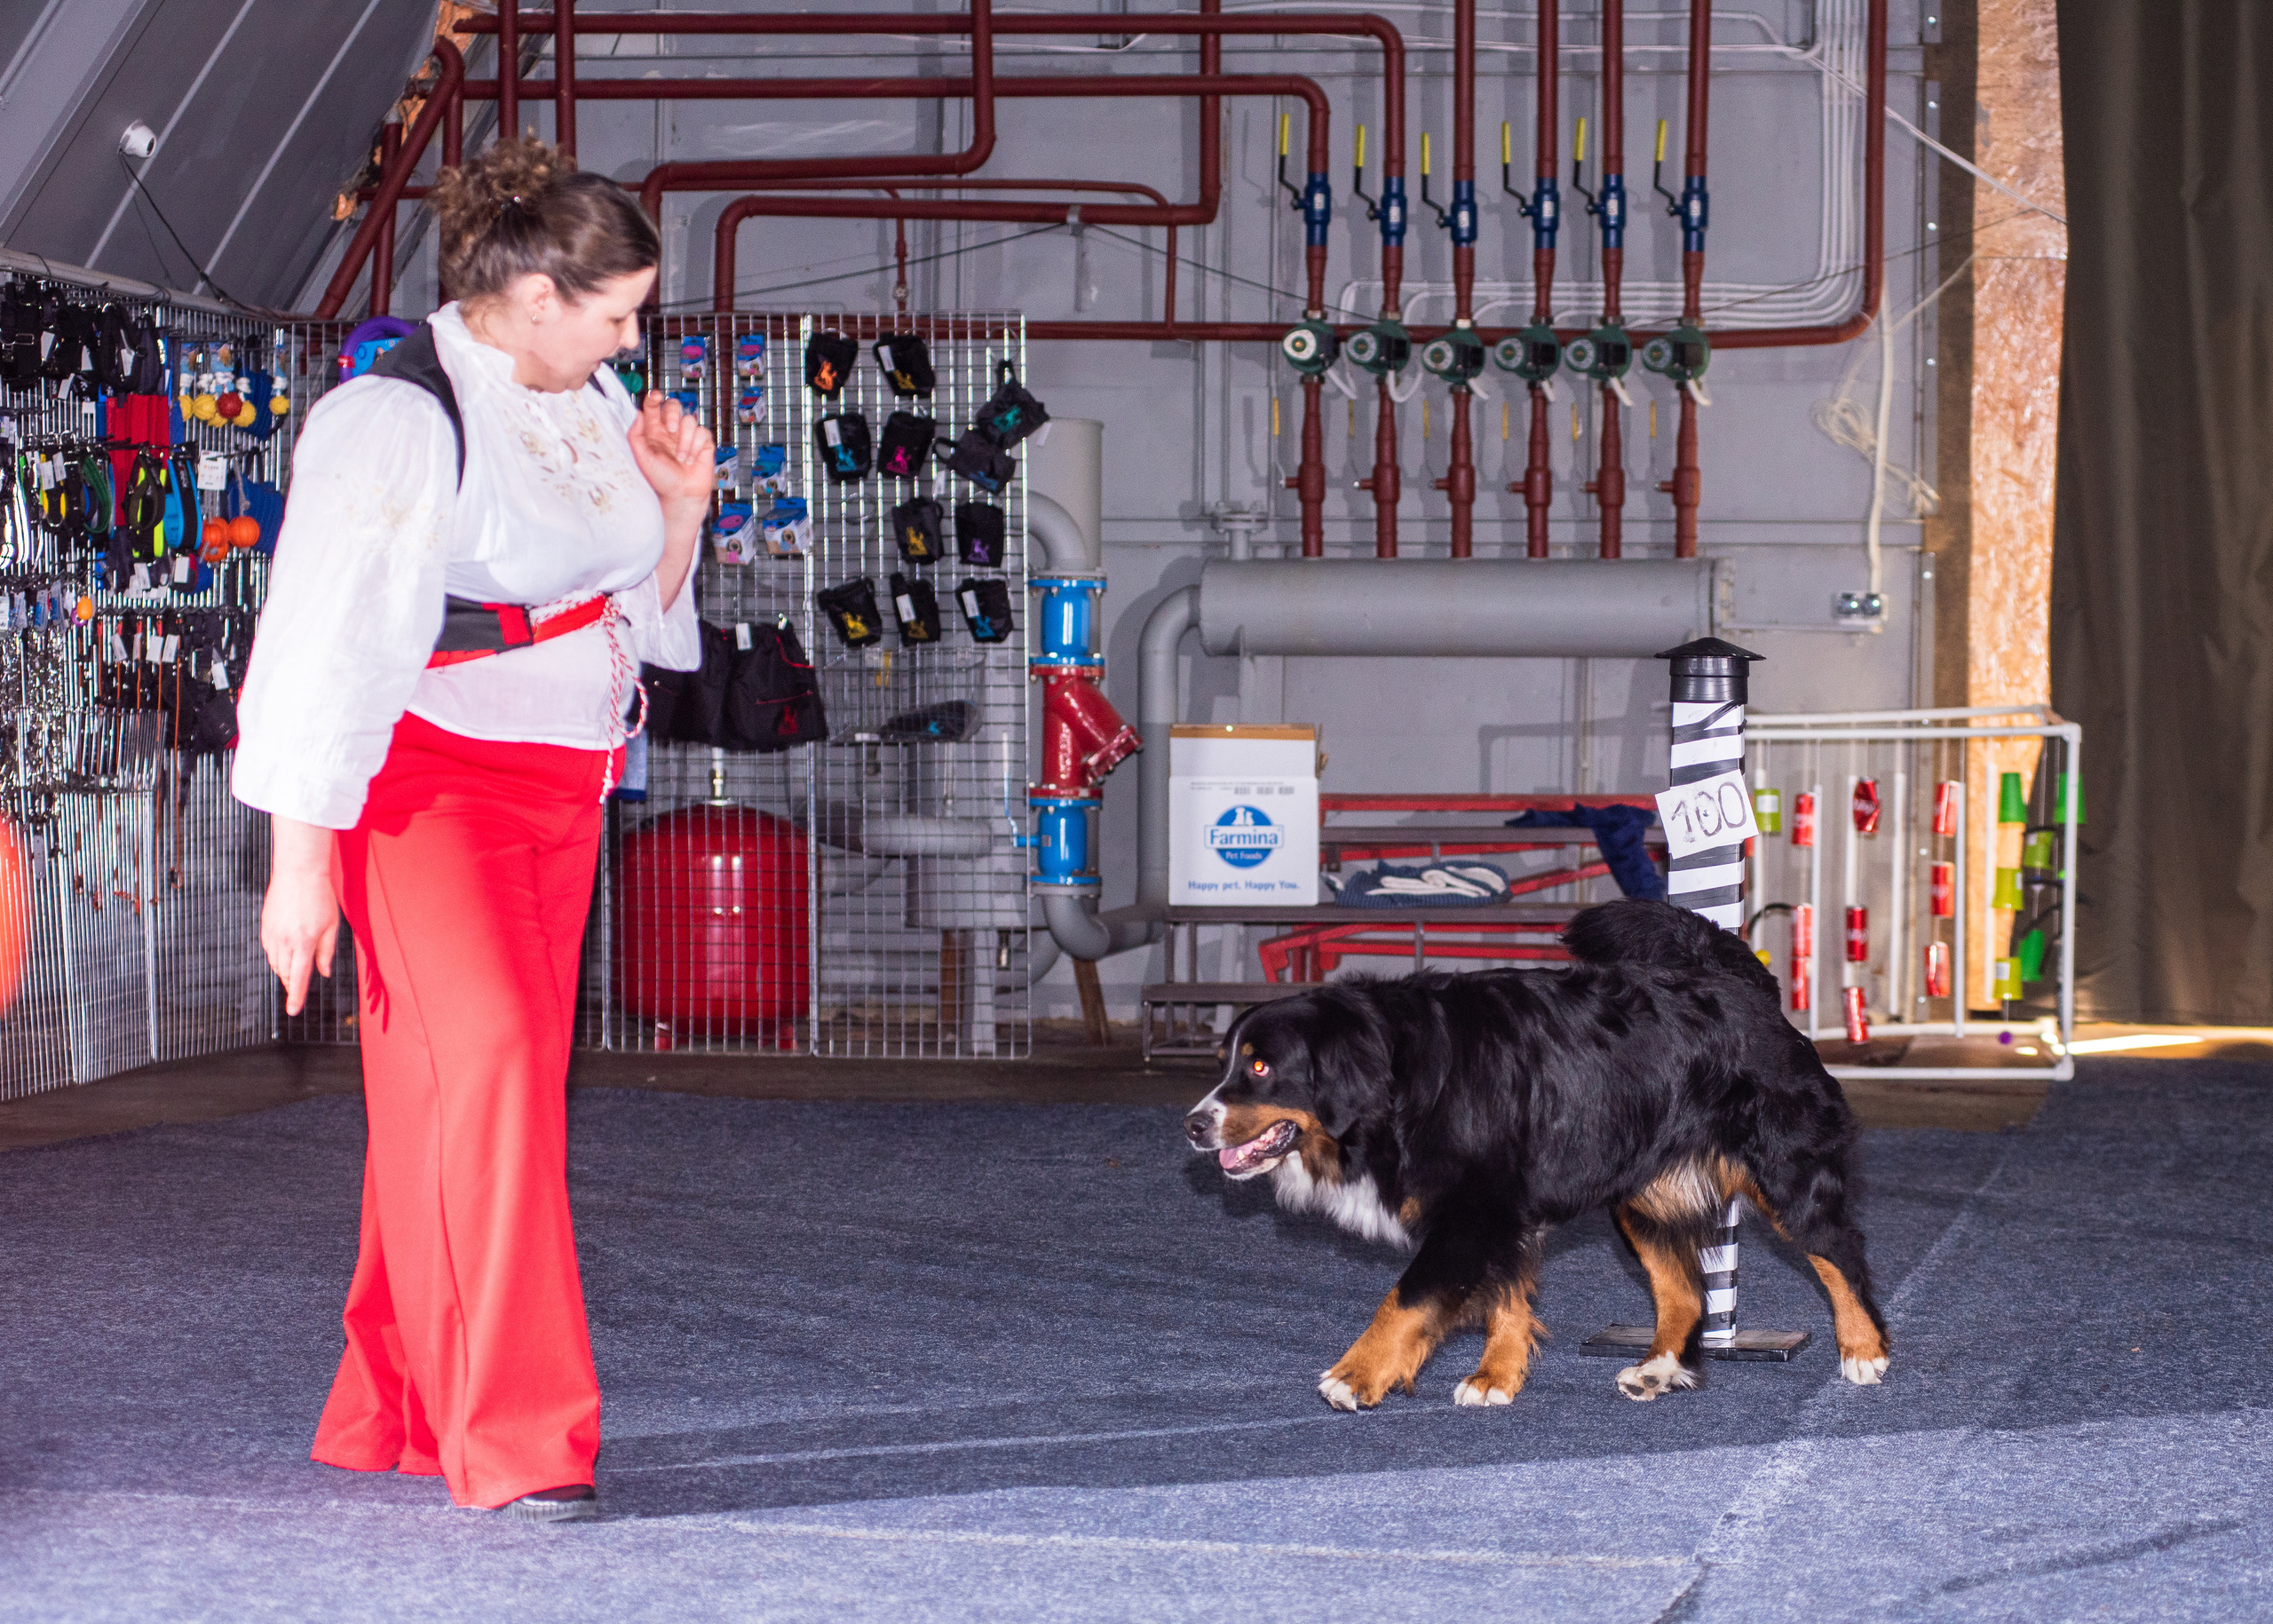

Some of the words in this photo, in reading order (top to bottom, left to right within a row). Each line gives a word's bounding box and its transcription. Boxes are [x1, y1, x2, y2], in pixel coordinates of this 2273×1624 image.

[1671, 781, 1747, 843] 100
[1210, 828, 1278, 844] Farmina
[1225, 851, 1239, 860] Pet
[1239, 851, 1263, 860] Foods
[1188, 880, 1218, 891] Happy
[1245, 880, 1275, 891] Happy
